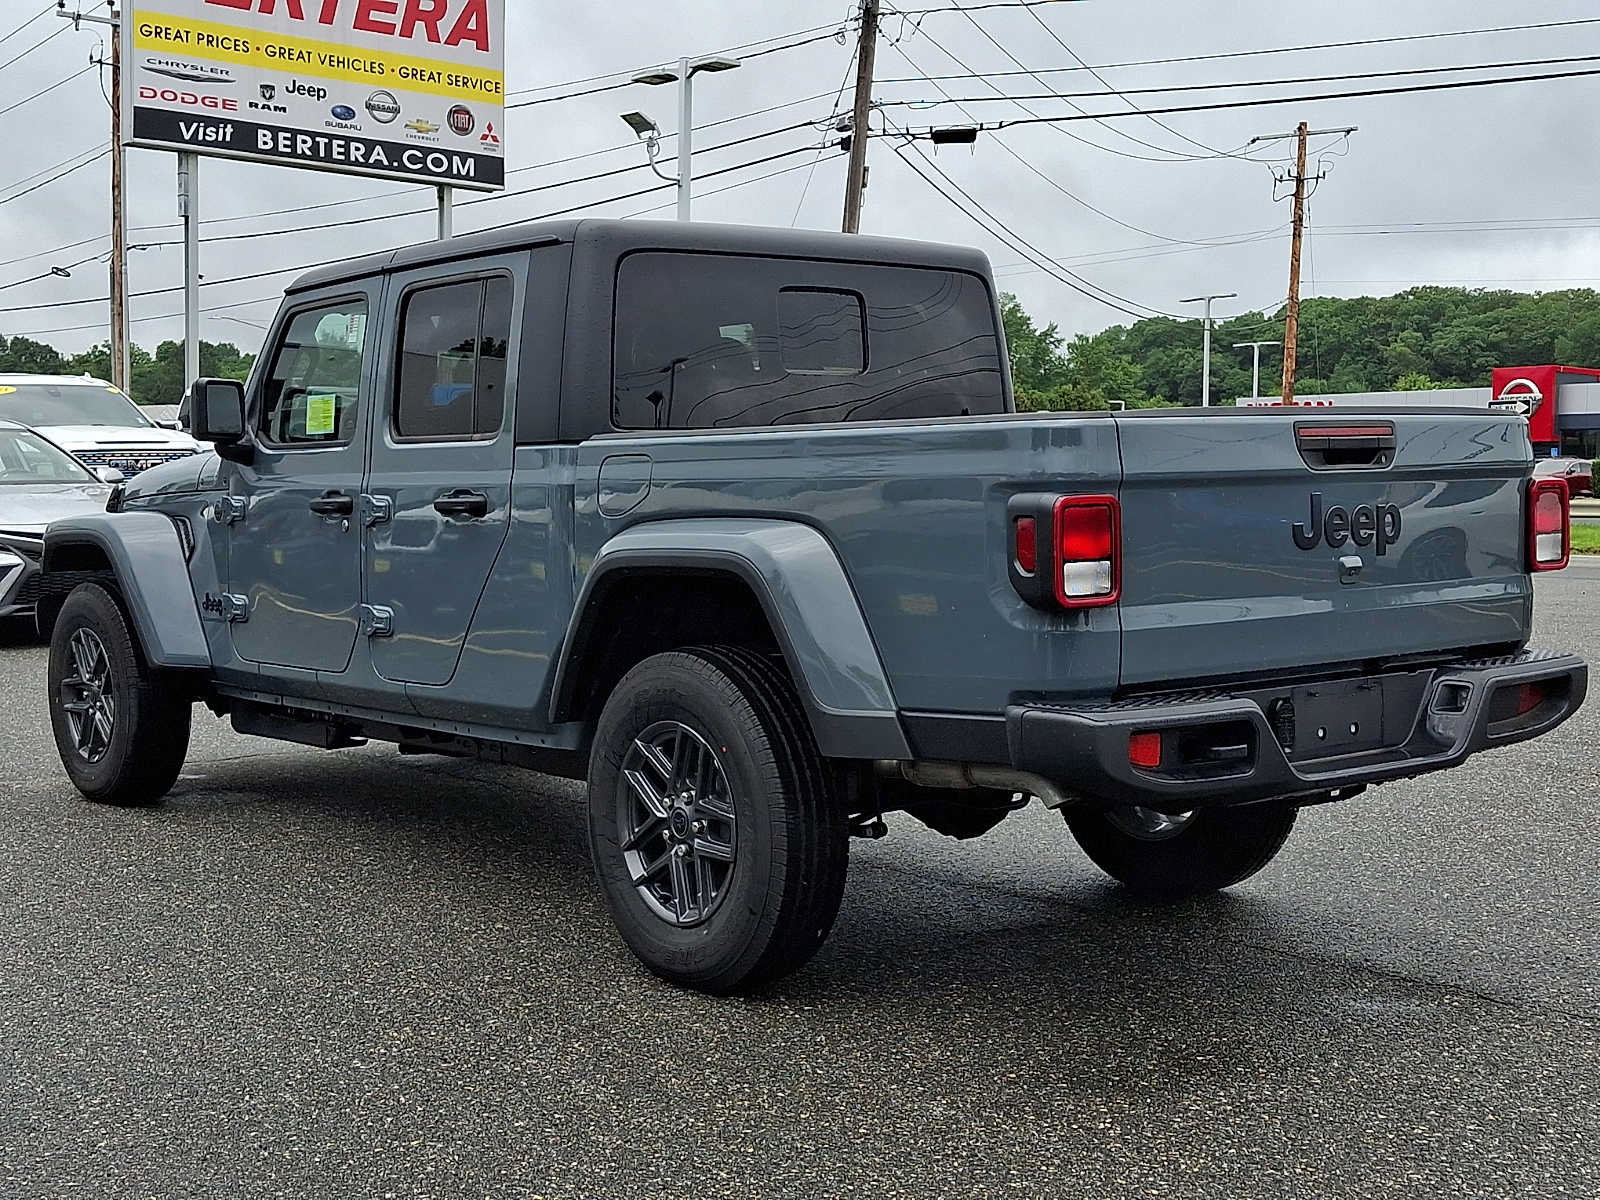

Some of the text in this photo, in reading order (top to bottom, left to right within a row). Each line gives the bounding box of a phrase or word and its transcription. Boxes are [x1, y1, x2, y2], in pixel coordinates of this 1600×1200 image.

[139, 24, 501, 94] GREAT PRICES GREAT VEHICLES GREAT SERVICE
[146, 58, 230, 76] CHRYSLER
[139, 86, 238, 111] DODGE
[285, 79, 327, 101] Jeep
[248, 101, 287, 113] RAM
[368, 102, 398, 113] NISSAN
[324, 120, 362, 132] SUBARU
[454, 113, 469, 128] FIAT
[405, 133, 440, 142] CHEVROLET
[178, 121, 475, 177] Visit BERTERA.COM
[1291, 491, 1402, 556] Jeep
